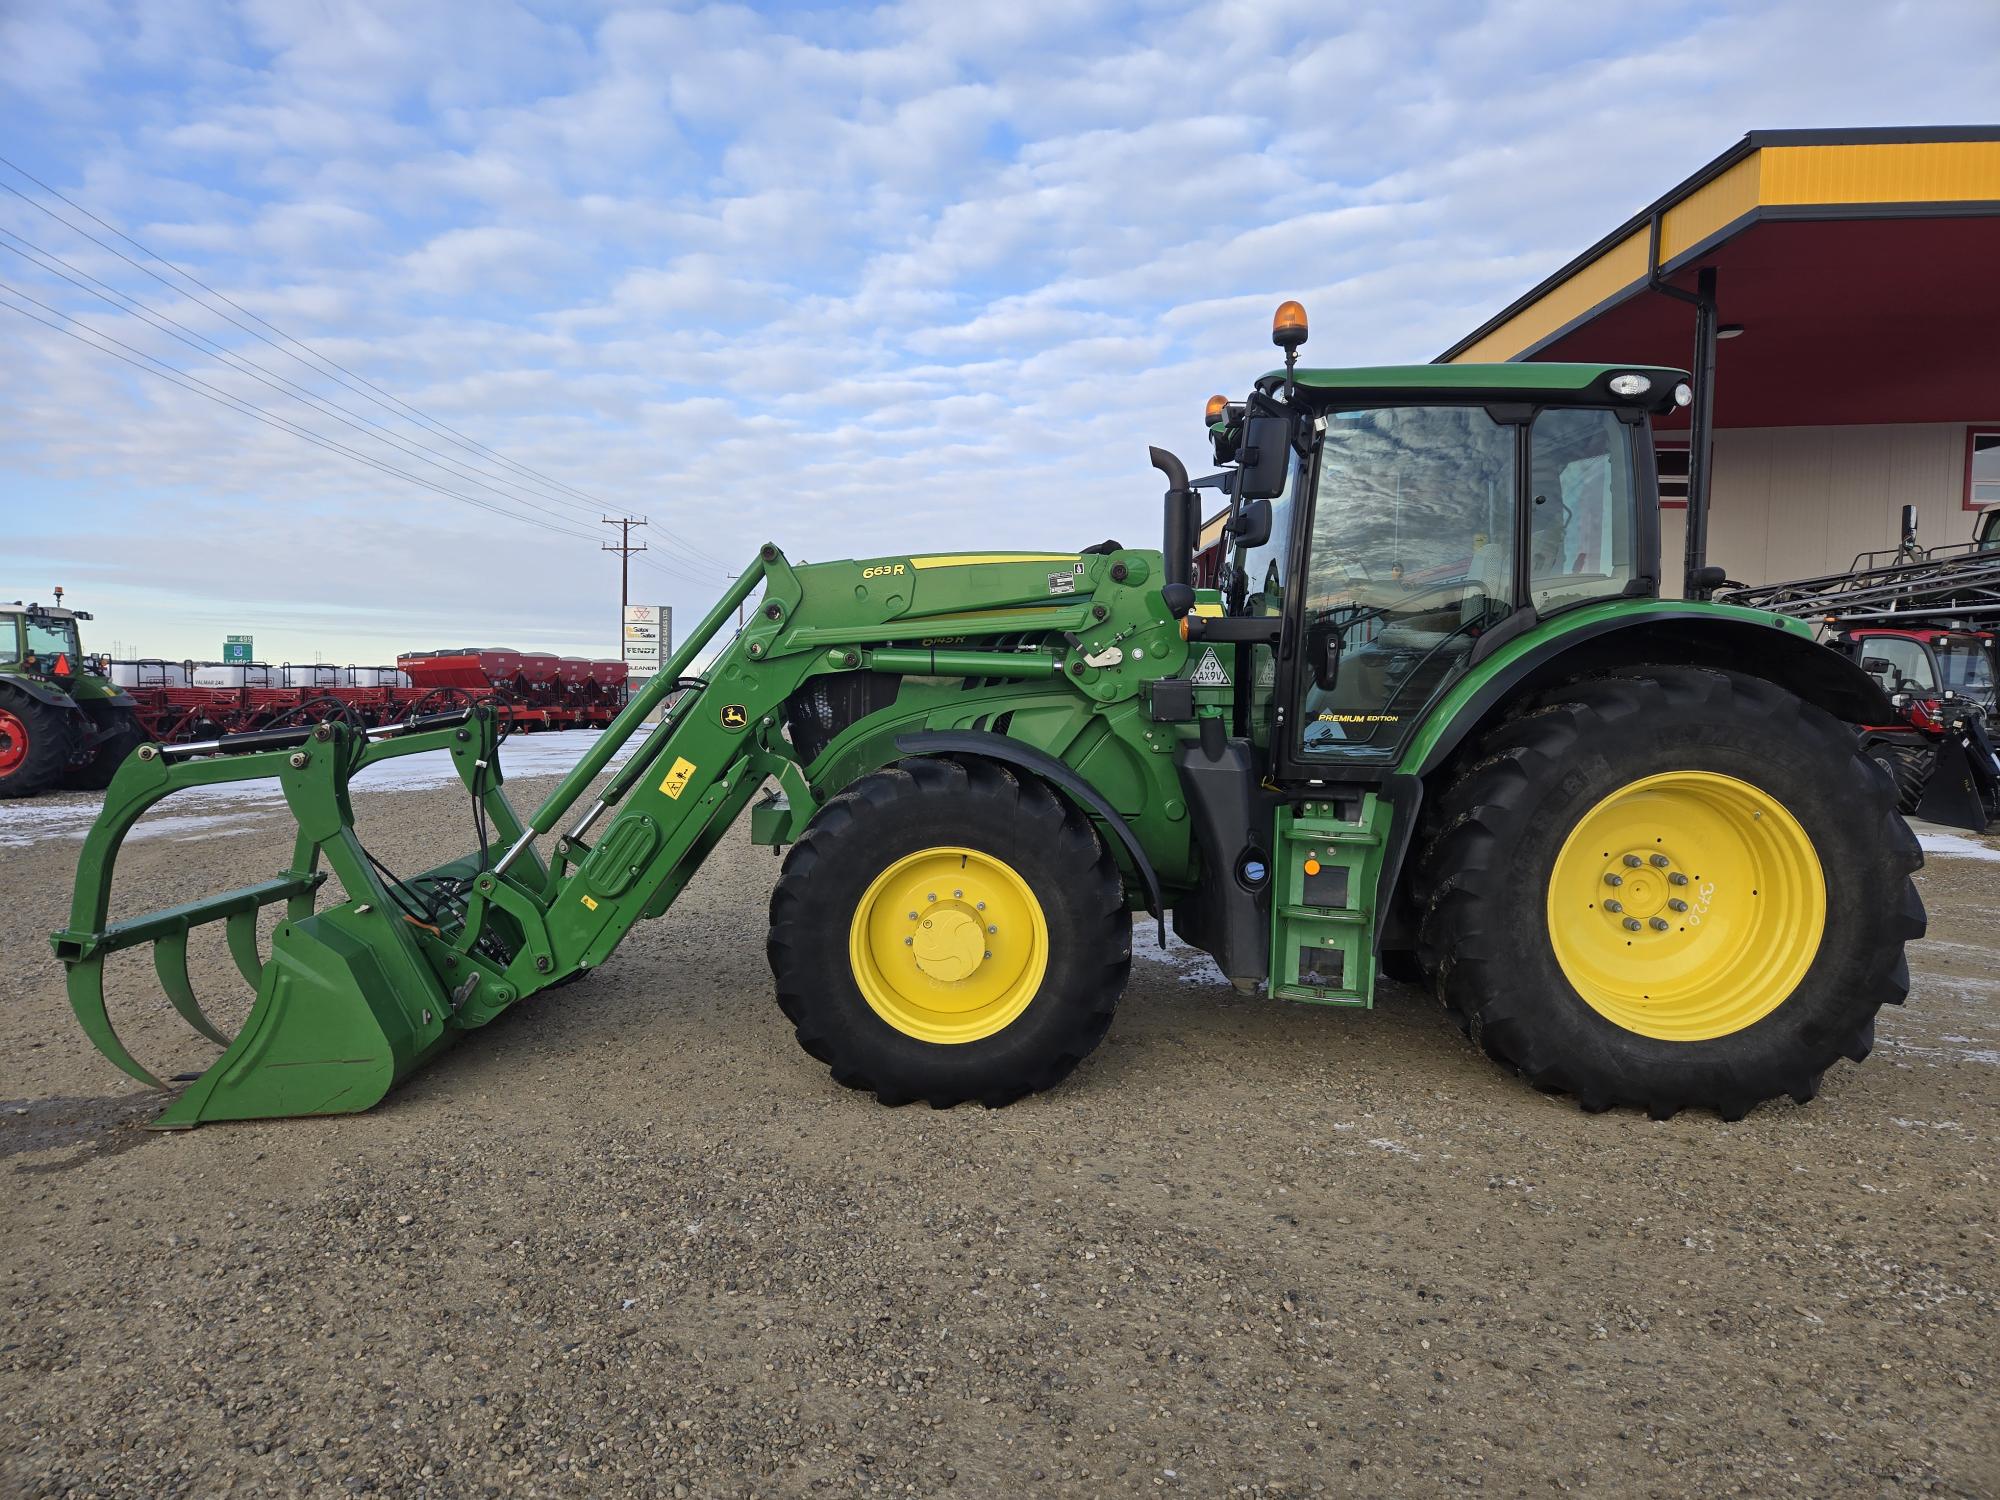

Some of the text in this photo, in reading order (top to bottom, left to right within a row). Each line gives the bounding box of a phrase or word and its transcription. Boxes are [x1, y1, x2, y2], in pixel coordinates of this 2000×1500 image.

[1204, 661, 1216, 671] 49
[1198, 671, 1222, 681] AX9V
[1318, 714, 1365, 722] PREMIUM
